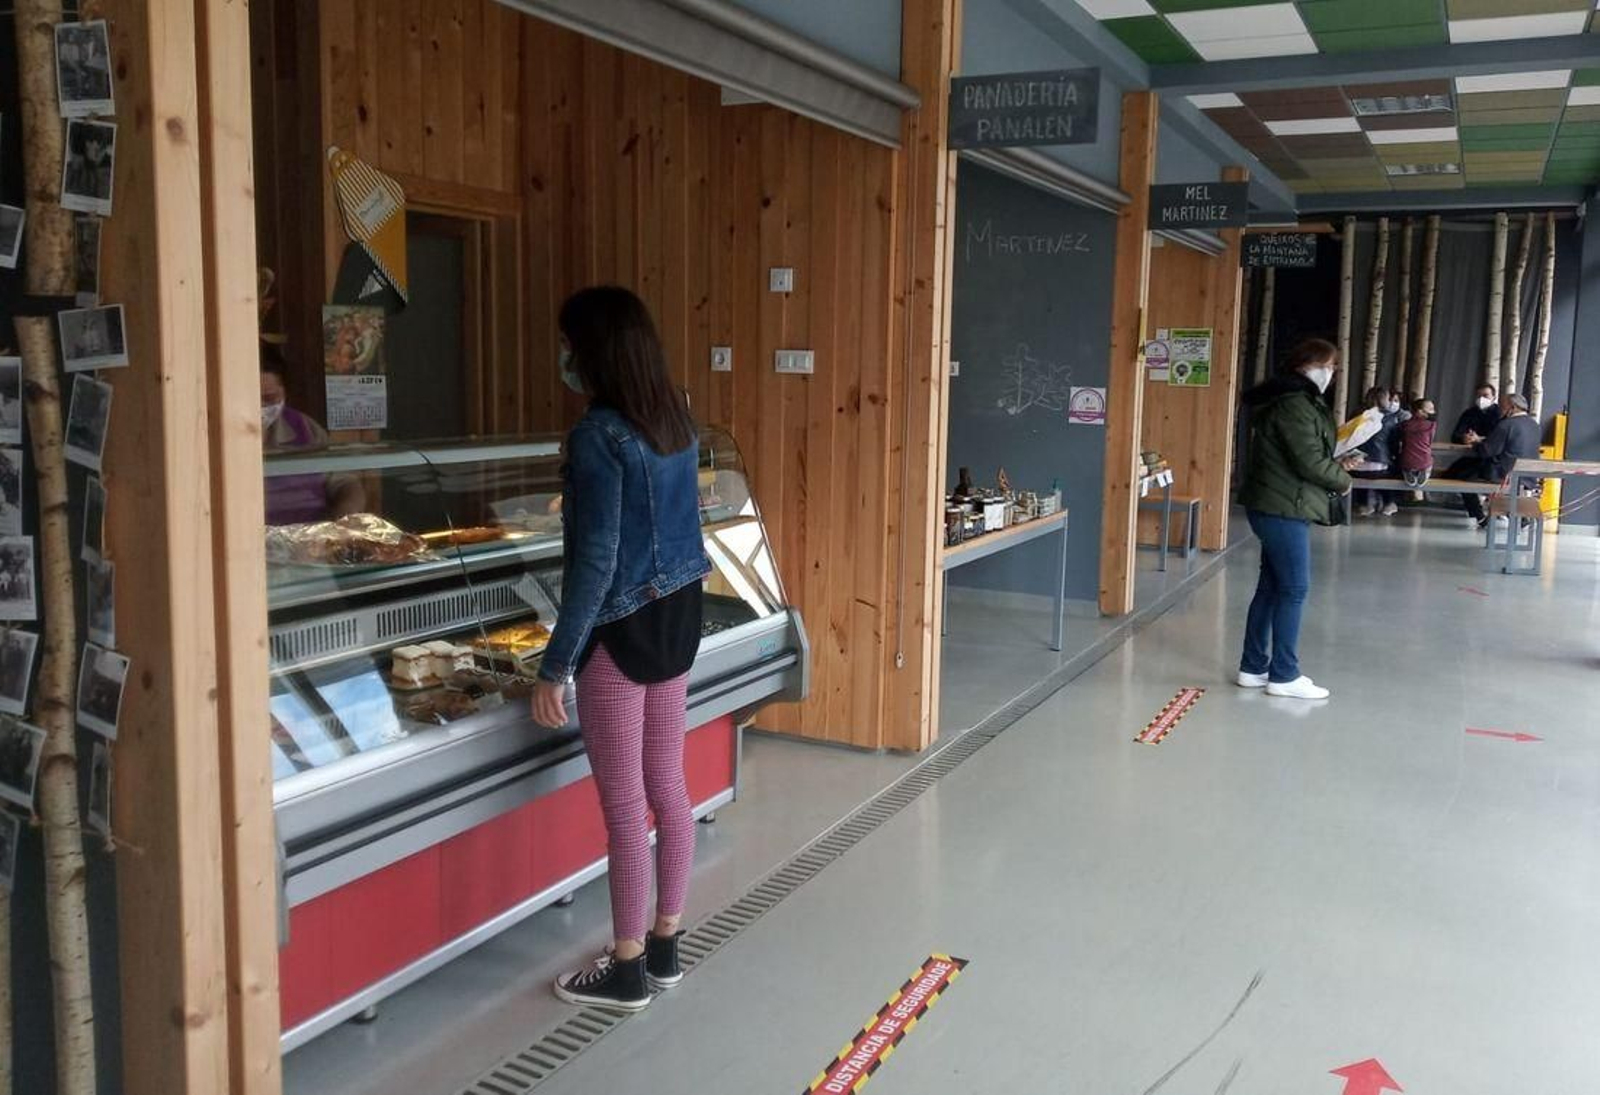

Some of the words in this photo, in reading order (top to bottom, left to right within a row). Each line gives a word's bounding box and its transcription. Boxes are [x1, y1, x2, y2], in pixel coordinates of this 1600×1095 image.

[977, 114, 1072, 141] PANALEN
[1185, 186, 1212, 199] MEL
[1162, 205, 1228, 221] MARTINEZ
[825, 1033, 888, 1093] DISTANCIA
[878, 1018, 900, 1034] DE
[892, 961, 951, 1019] SEGURIDADE
